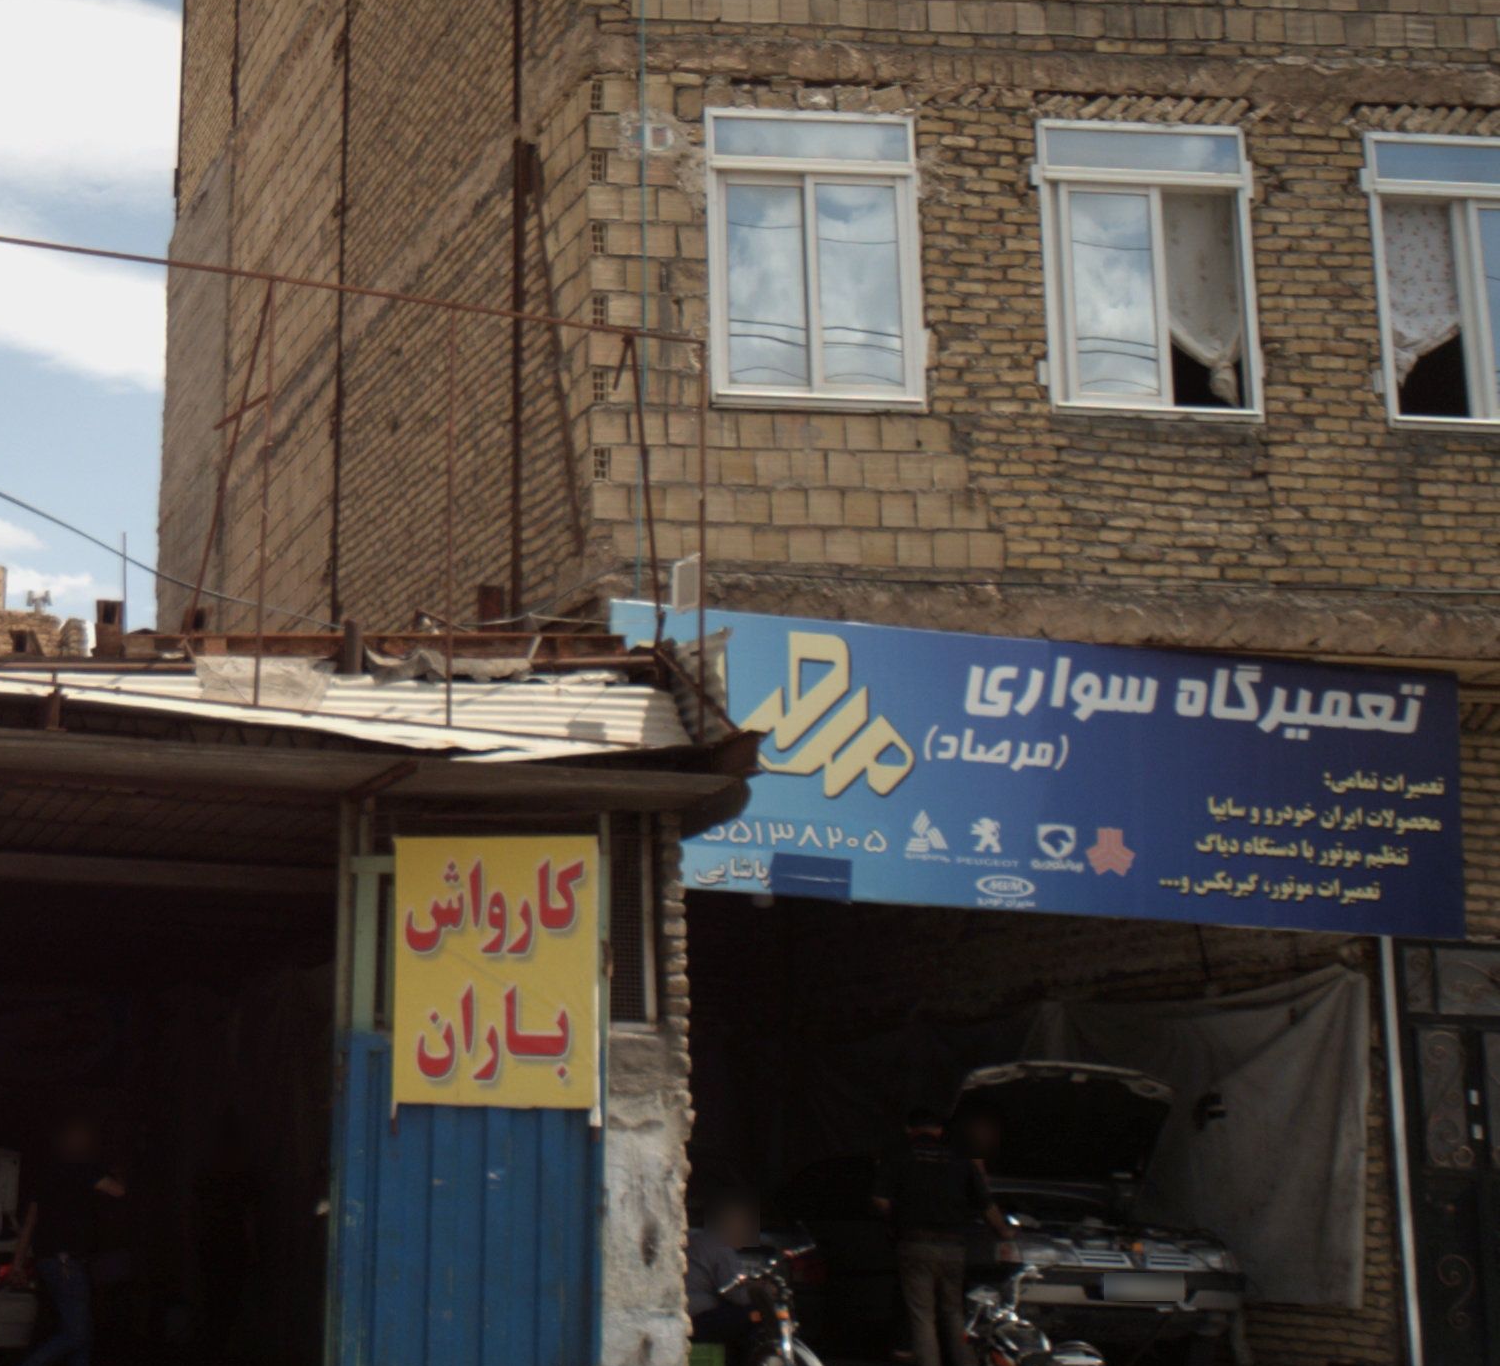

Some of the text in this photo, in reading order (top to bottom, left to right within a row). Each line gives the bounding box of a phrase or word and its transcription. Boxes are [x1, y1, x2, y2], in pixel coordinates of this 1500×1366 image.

[964, 657, 1425, 740] تعمیرگاه سواری
[924, 725, 1069, 771] (مرصاد)
[1323, 770, 1445, 799] تعمیرات تمامی:
[1206, 795, 1247, 822] سایپا
[1264, 803, 1316, 827] خودرو
[1320, 805, 1363, 831] ایران
[1366, 809, 1442, 834] محصولات
[1243, 835, 1299, 858] دستگاه
[1301, 839, 1315, 863] با
[1318, 841, 1362, 868] موتور
[1364, 845, 1410, 869] تنظیم
[694, 857, 773, 889] پاشایی
[1317, 878, 1382, 904] تعمیرات
[405, 860, 585, 954] کارواش
[416, 985, 570, 1081] باران
